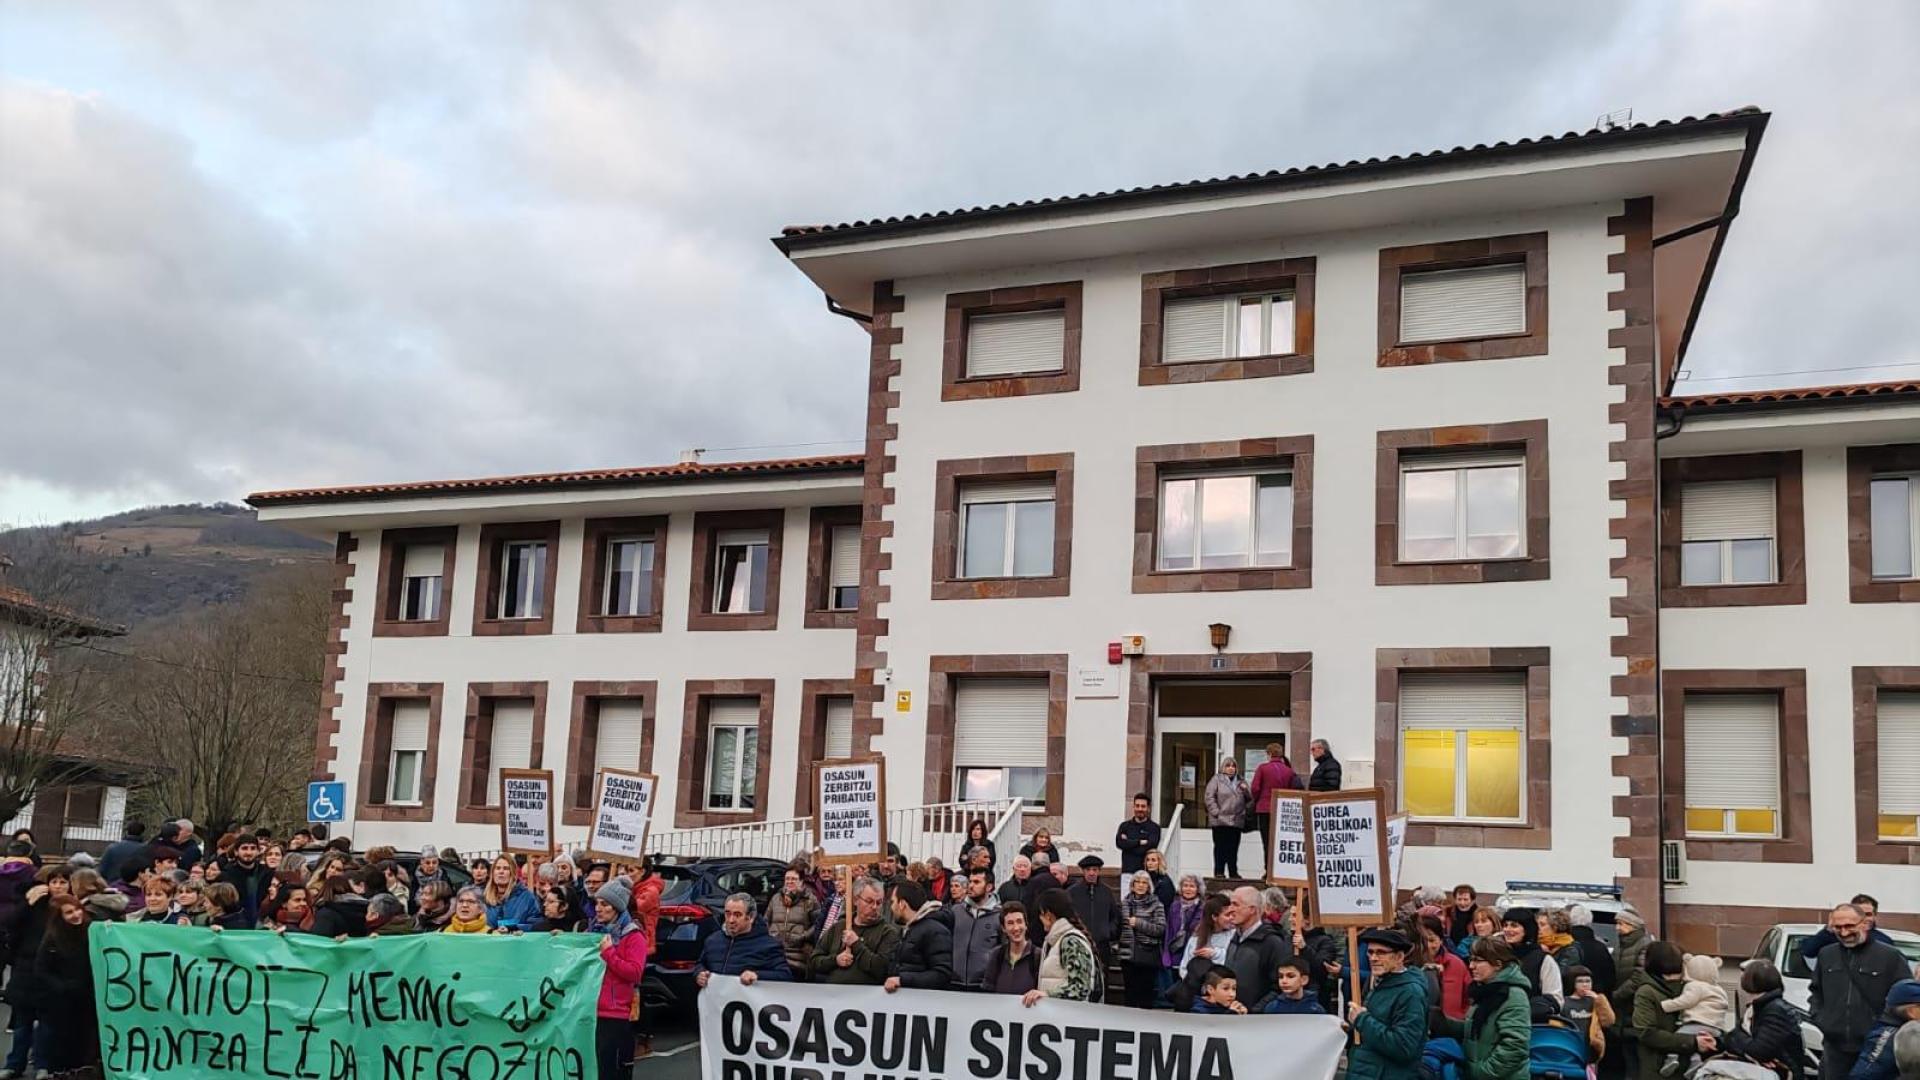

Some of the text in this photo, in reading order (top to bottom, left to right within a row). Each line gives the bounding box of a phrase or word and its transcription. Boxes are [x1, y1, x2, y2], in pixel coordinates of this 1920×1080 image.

[825, 770, 865, 781] OSASUN
[507, 780, 541, 791] OSASUN
[607, 777, 643, 791] OSASUN
[824, 781, 872, 793] ZERBITZU
[508, 791, 547, 801] ZERBITZU
[604, 787, 647, 802] ZERBITZU
[824, 792, 876, 804] PRIBATUEI
[508, 801, 544, 810] PUBLIKO
[603, 798, 641, 811] PUBLIKO
[600, 814, 612, 822] ETA
[824, 810, 870, 821] BALIABIDE
[1313, 805, 1350, 819] GUREA
[824, 819, 873, 830] BAKAR BAT
[1314, 818, 1372, 832] PUBLIKOA!
[824, 830, 854, 840] ERE EZ
[1315, 832, 1360, 844] OSASUN-
[1316, 844, 1346, 855] BIDEA
[1317, 859, 1363, 873] ZAINDU
[1318, 874, 1375, 888] DEZAGUN
[721, 1000, 1234, 1080] OSASUN SISTEMA
